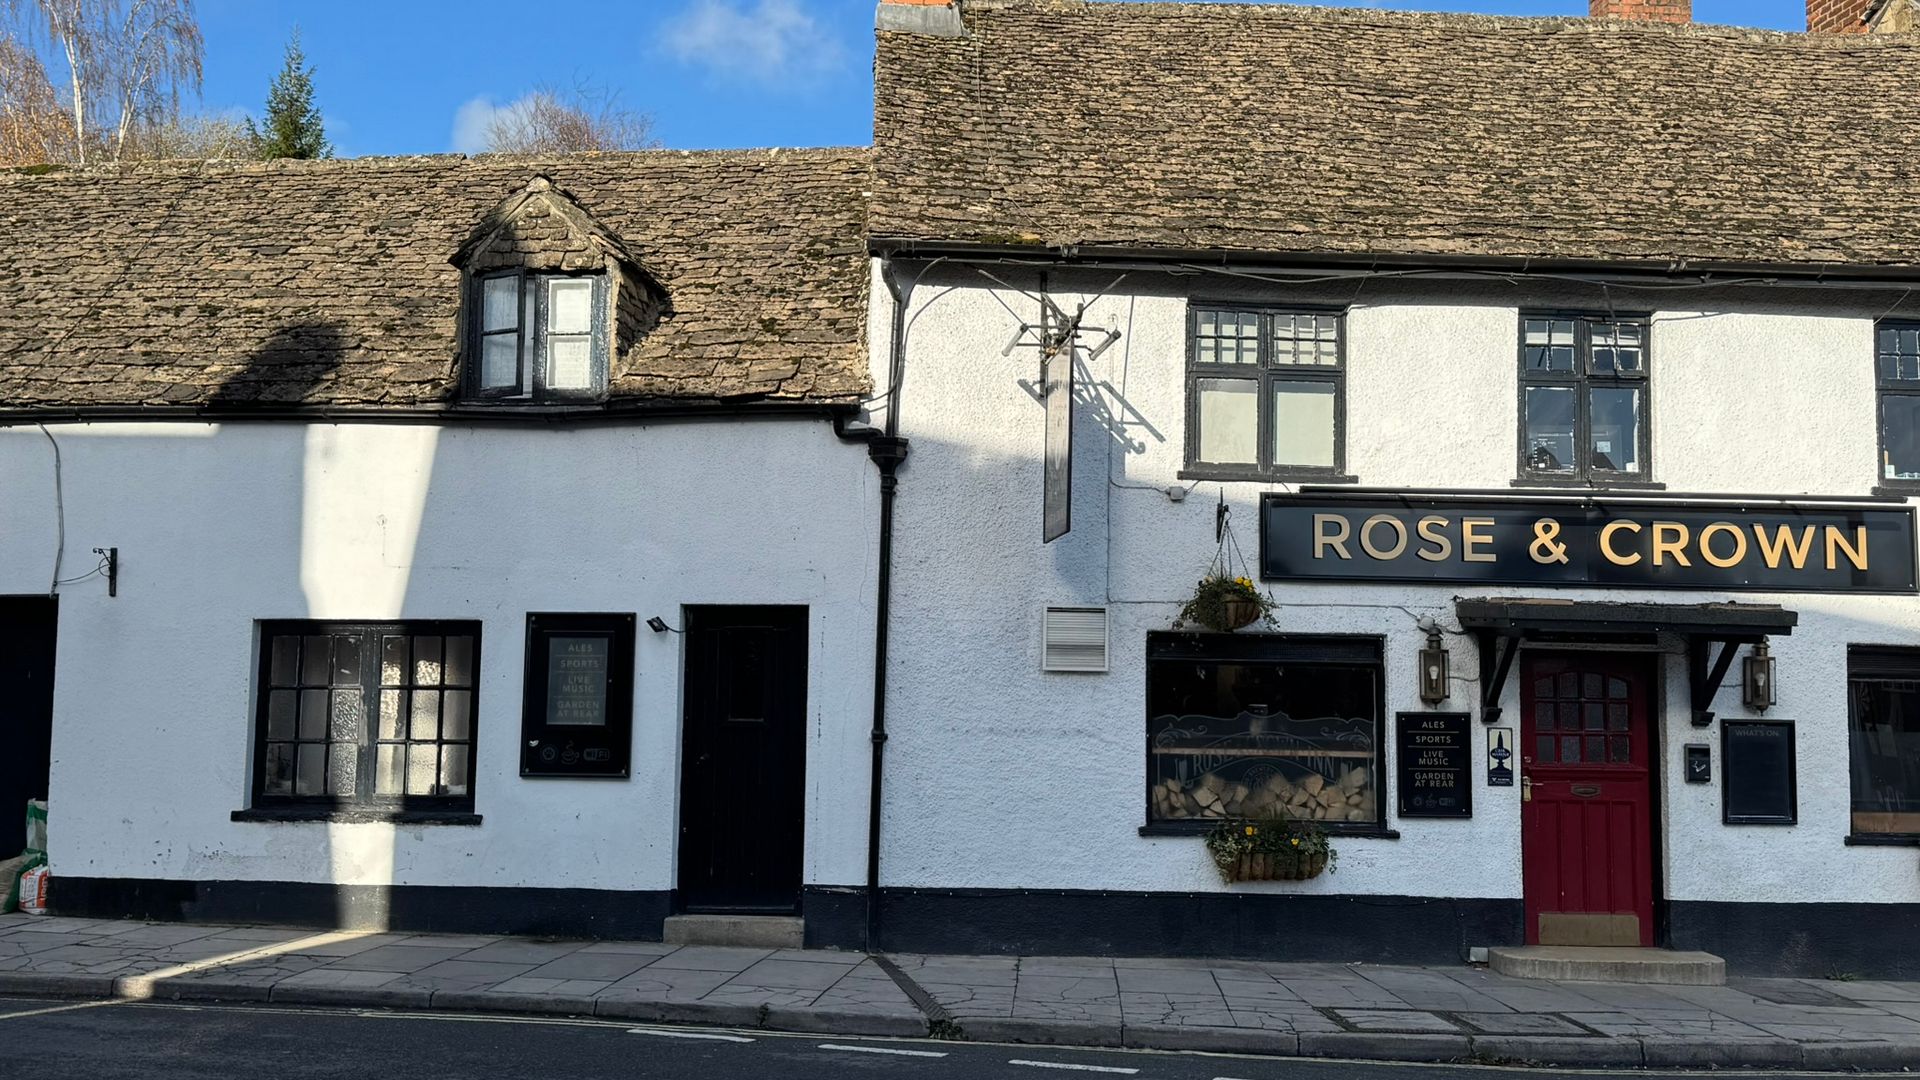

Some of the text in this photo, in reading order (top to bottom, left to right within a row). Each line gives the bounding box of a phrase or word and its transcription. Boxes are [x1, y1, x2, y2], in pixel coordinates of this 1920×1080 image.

[1312, 513, 1869, 571] ROSE & CROWN
[567, 643, 593, 653] ALES
[560, 659, 600, 668] SPORTS
[567, 675, 591, 684] LIVE
[562, 683, 595, 693] MUSIC
[557, 700, 600, 708] GARDEN
[556, 709, 600, 718] AT REAR
[1421, 721, 1445, 729] ALES
[1766, 729, 1780, 737] ON
[1415, 735, 1452, 744] SPORTS
[1423, 750, 1444, 758] LIVE
[1306, 746, 1335, 778] INN
[1418, 758, 1449, 766] MUSIC
[1414, 772, 1454, 780] GARDEN
[1414, 780, 1454, 788] AT REAR
